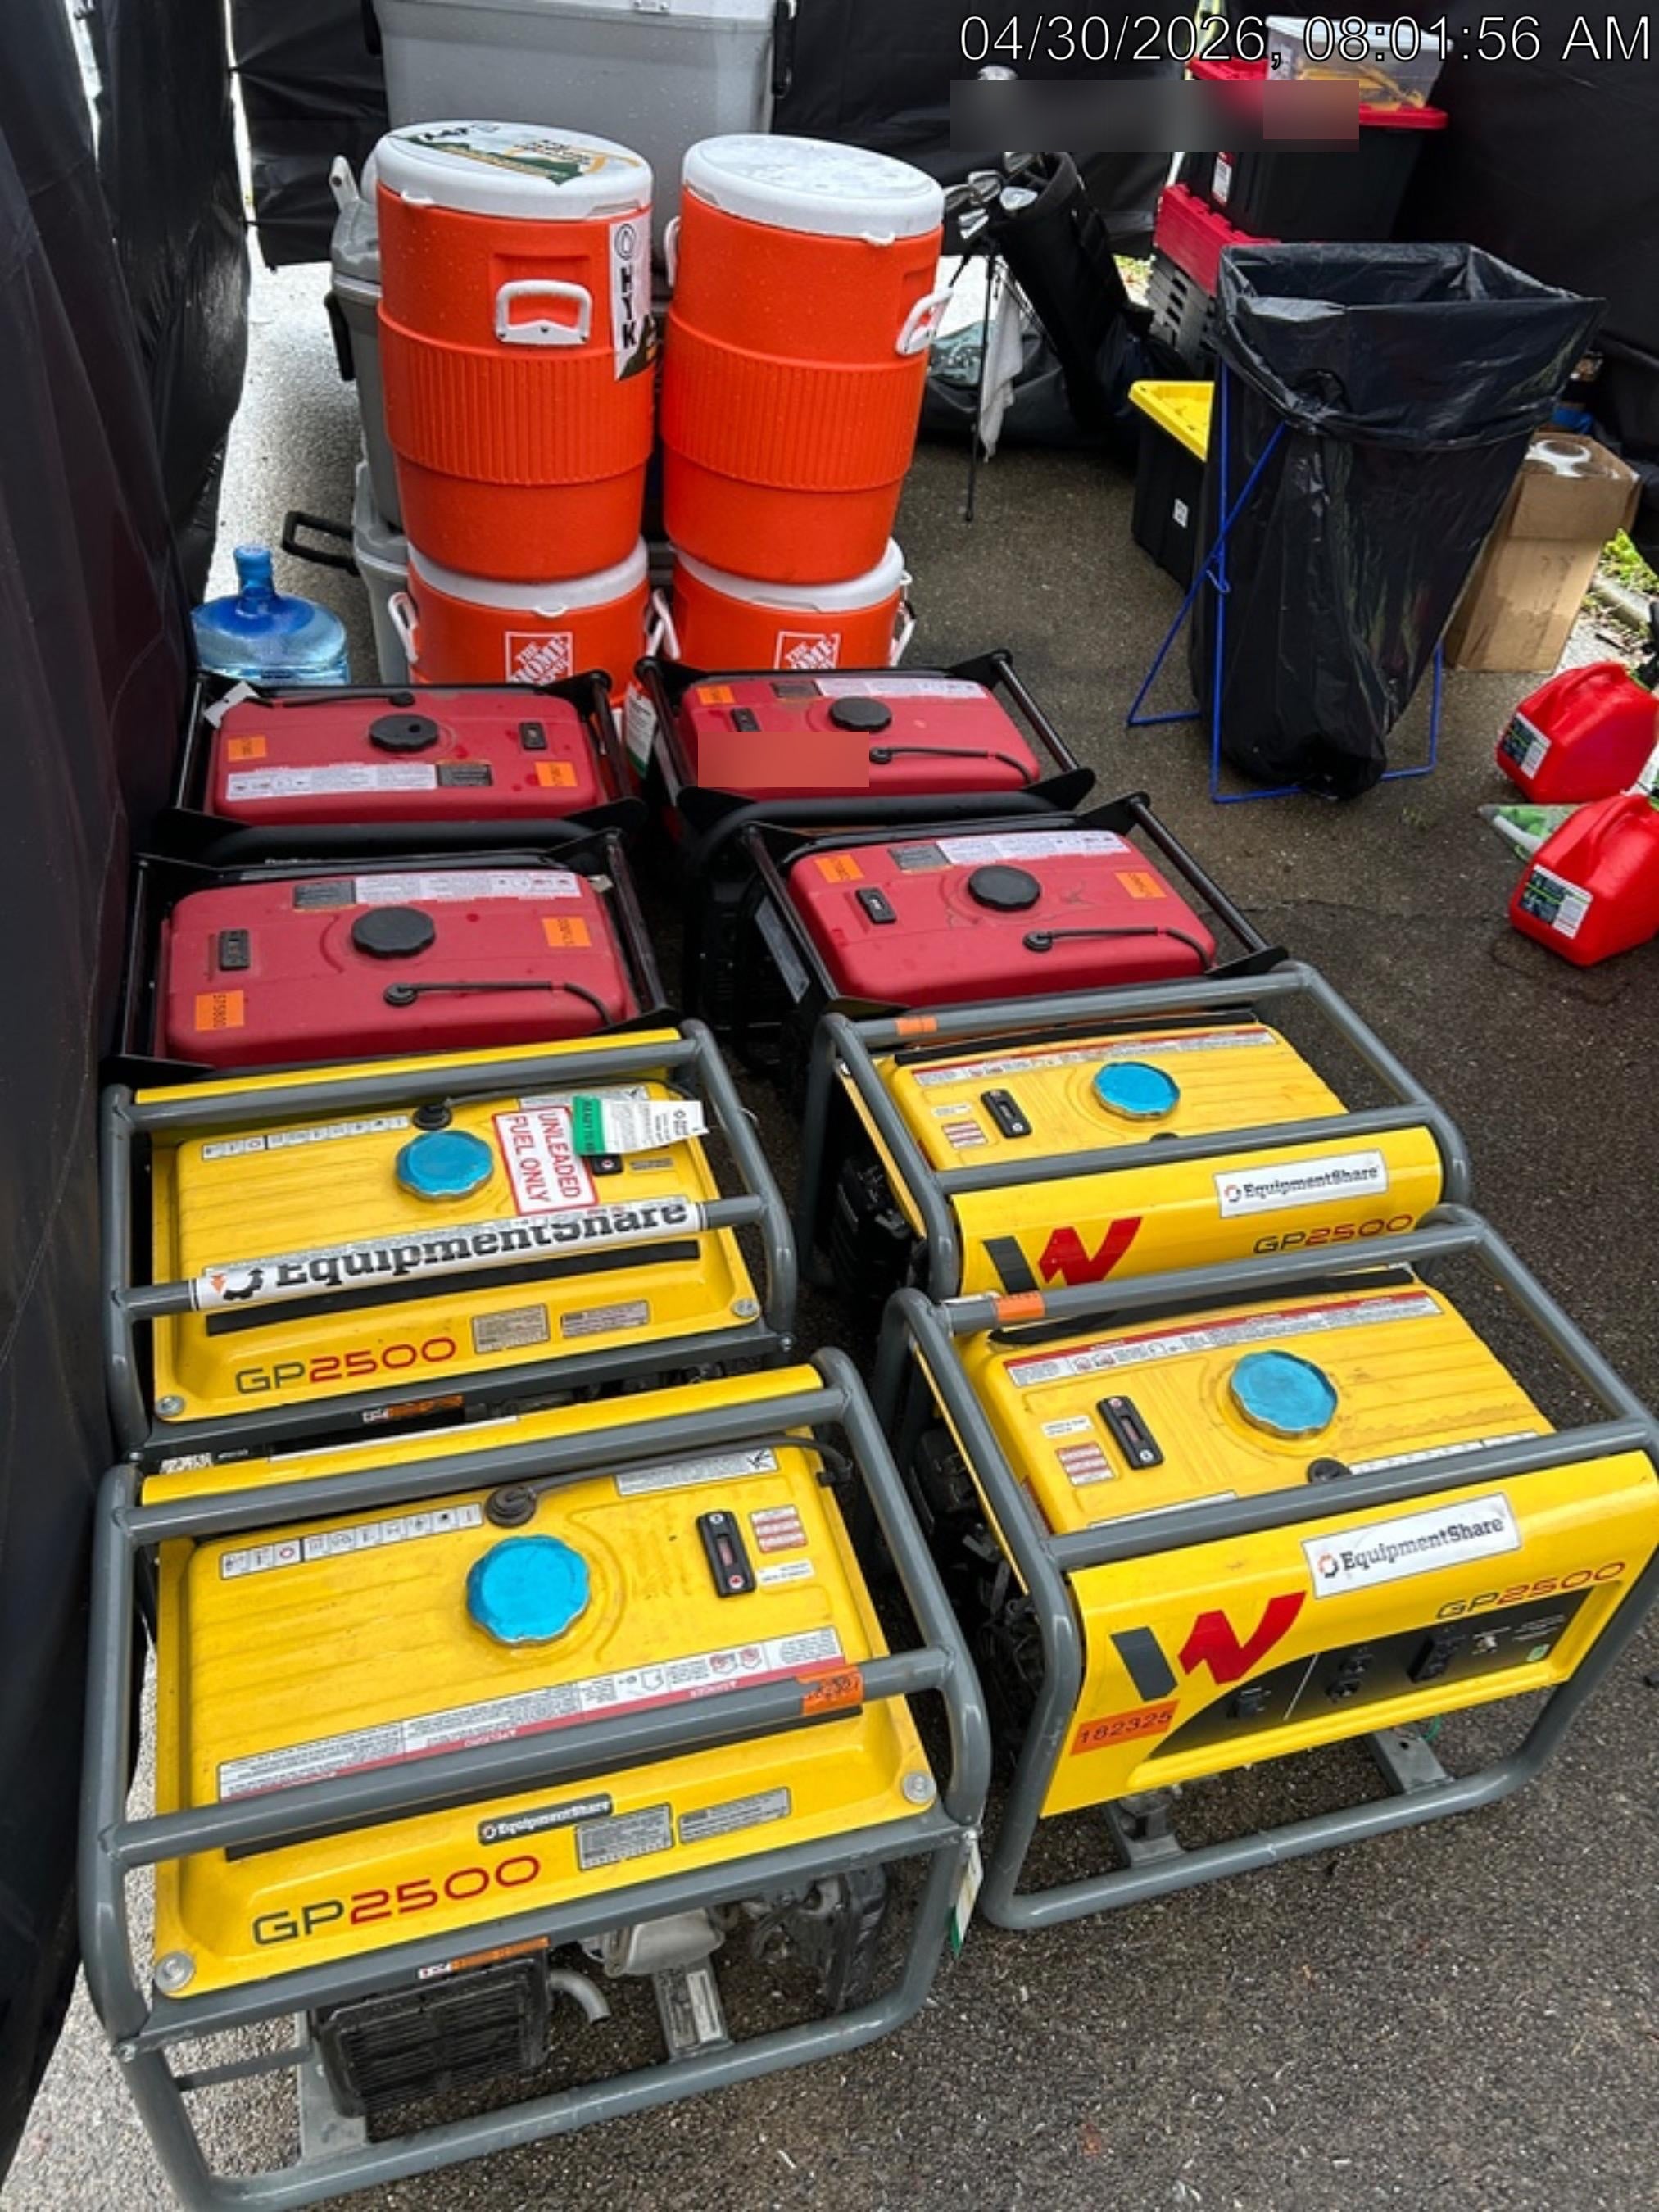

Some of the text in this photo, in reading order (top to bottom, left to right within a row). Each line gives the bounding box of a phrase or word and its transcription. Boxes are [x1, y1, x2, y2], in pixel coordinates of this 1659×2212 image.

[505, 1115, 551, 1202] FUEL ONLY
[537, 1112, 581, 1198] UNLEADED
[1243, 1167, 1378, 1199] EquipmentShare
[277, 1202, 687, 1288] EquipmentShare
[1253, 1214, 1413, 1253] GP2500
[236, 1337, 456, 1394] GP2500
[1340, 1516, 1503, 1571] EquipmentShare
[1436, 1561, 1626, 1620] GP2500
[1080, 1710, 1173, 1743] 182325
[252, 1855, 540, 1946] GP2500
